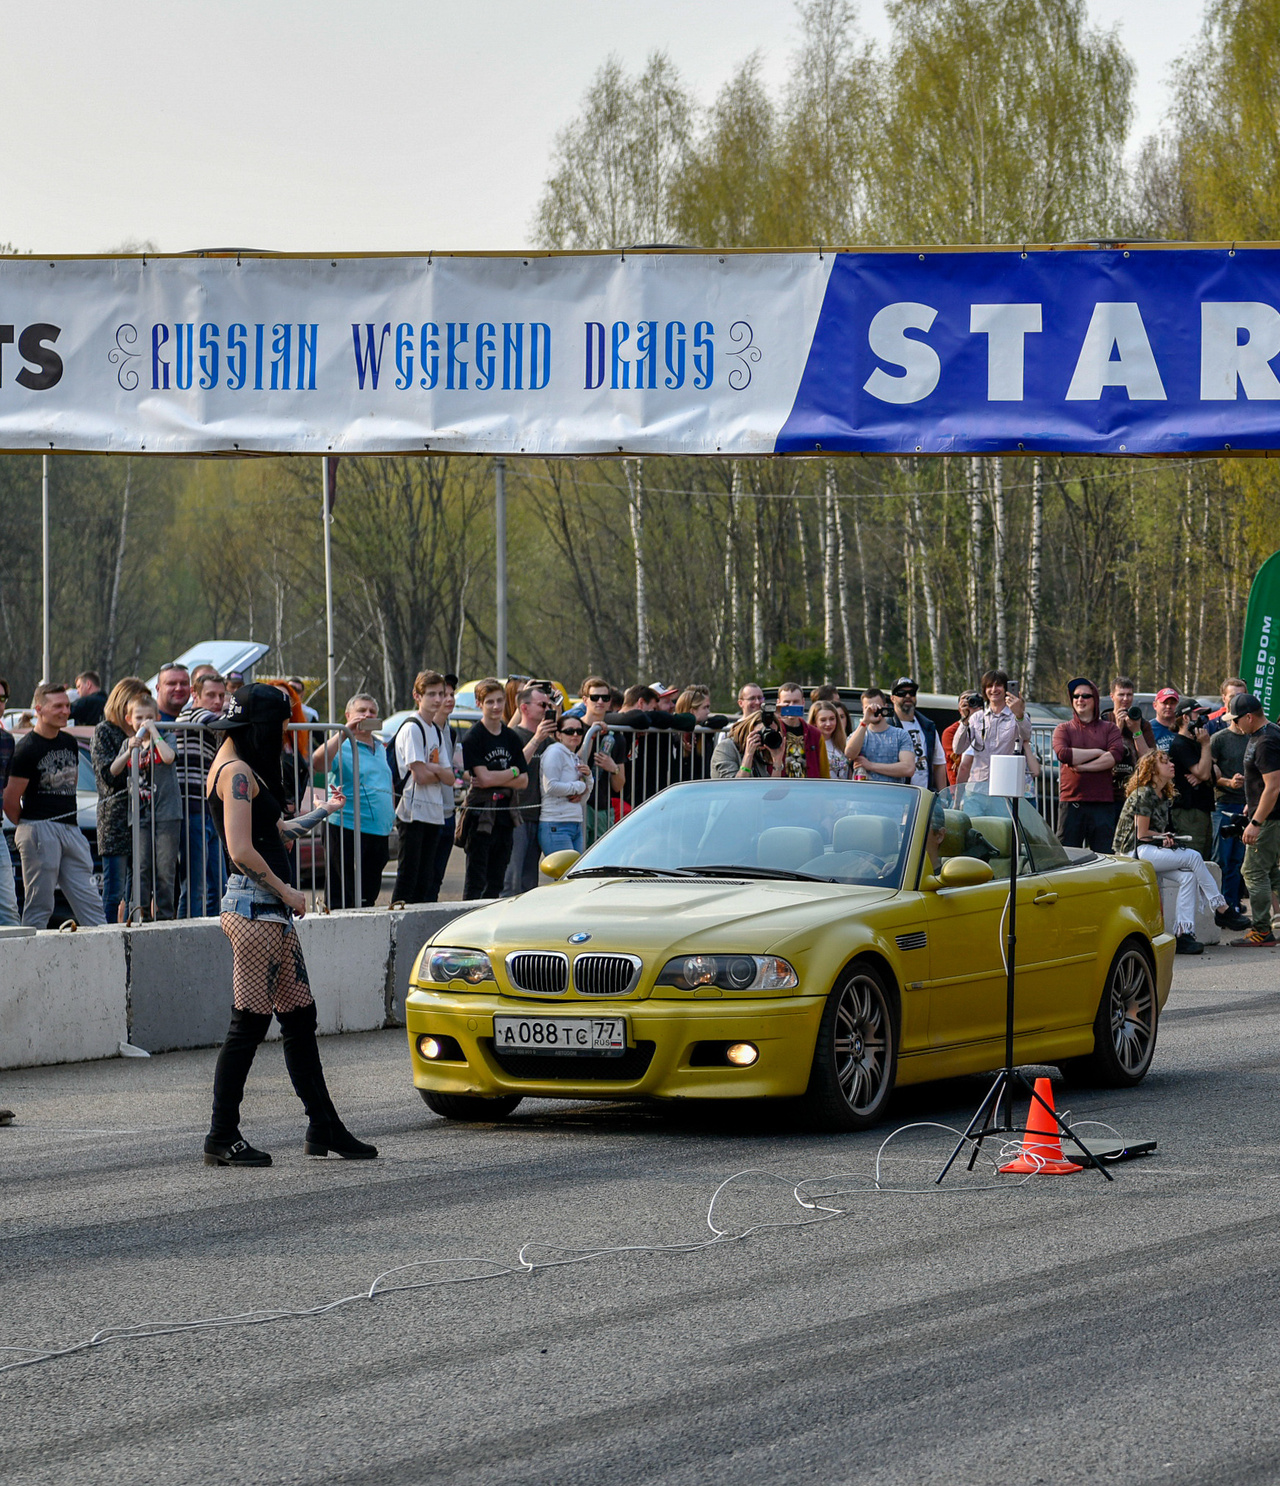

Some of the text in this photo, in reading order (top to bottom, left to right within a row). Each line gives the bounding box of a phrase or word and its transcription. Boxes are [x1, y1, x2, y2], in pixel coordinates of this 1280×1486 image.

[151, 321, 715, 391] RUSSIAN WEEKEND DRAGS
[1253, 615, 1273, 702] REEDOM
[593, 1039, 611, 1047] RUS
[594, 1022, 616, 1040] 77
